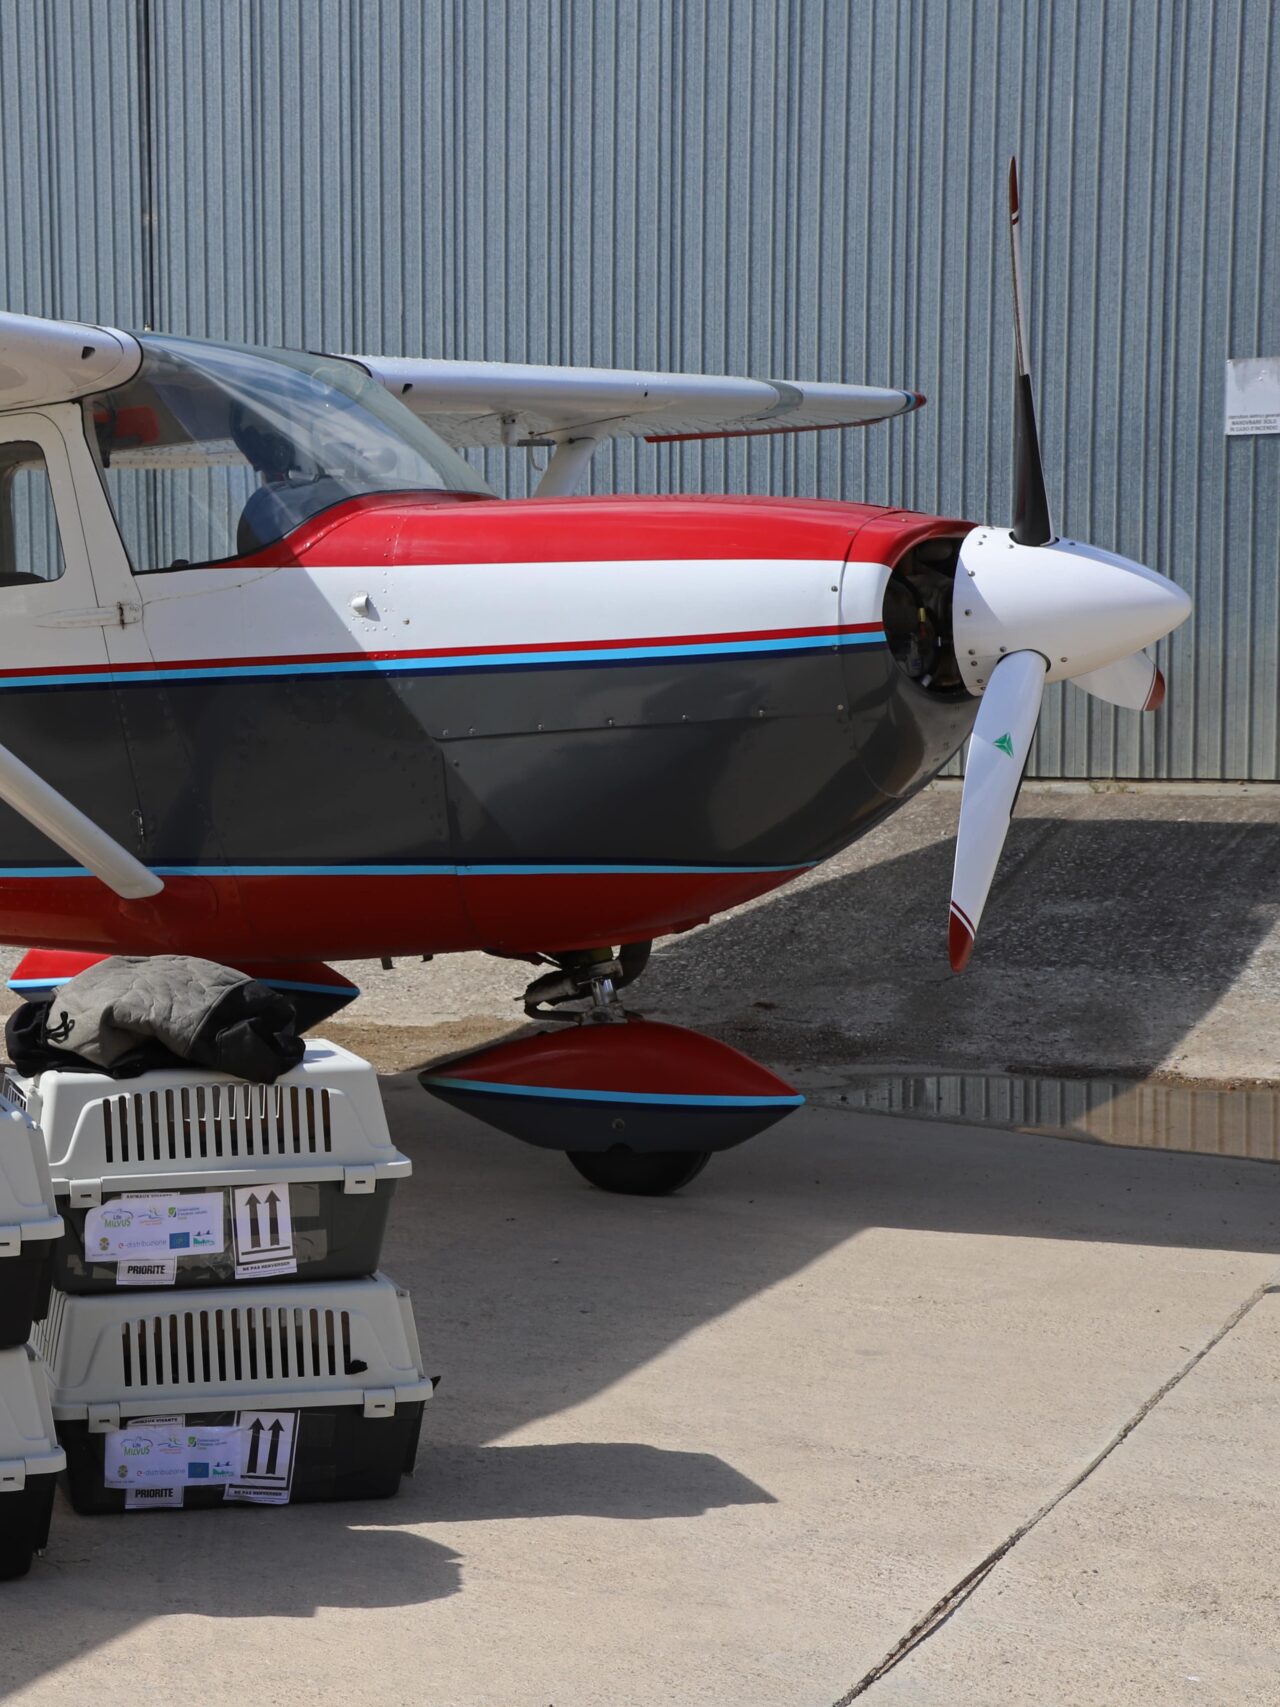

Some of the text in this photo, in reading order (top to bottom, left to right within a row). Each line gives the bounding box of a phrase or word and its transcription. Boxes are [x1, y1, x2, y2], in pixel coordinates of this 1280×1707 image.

[104, 1217, 131, 1228] MILVUS
[127, 1265, 166, 1274] PRIORITE
[124, 1446, 150, 1456] MILVUS
[135, 1488, 174, 1498] PRIORITE
